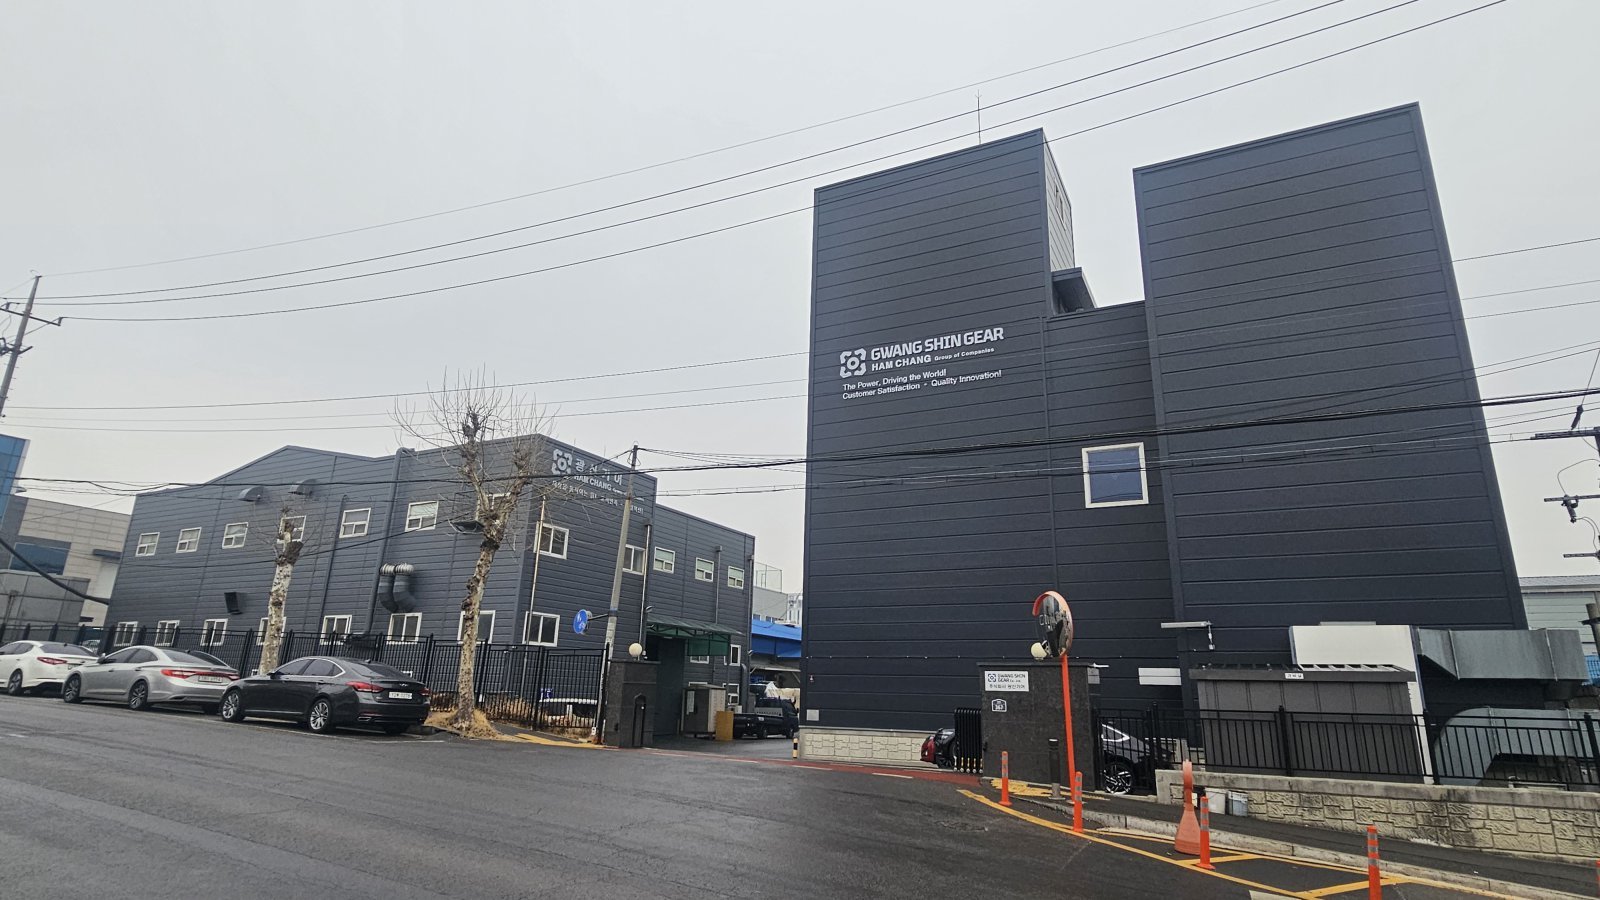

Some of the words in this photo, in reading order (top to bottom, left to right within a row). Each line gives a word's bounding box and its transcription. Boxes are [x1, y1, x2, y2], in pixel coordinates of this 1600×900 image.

[870, 340, 923, 361] GWANG
[924, 334, 962, 353] SHIN
[963, 327, 1004, 345] GEAR
[871, 361, 894, 372] HAM
[895, 354, 932, 369] CHANG
[934, 353, 953, 361] Group
[961, 347, 995, 358] Companies
[842, 383, 856, 391] The
[857, 380, 881, 390] Power,
[883, 374, 908, 386] Driving
[909, 373, 921, 381] the
[922, 369, 947, 379] World!
[842, 389, 876, 400] Customer
[877, 382, 921, 396] Satisfaction
[931, 376, 958, 388] Quality
[958, 370, 1002, 383] Innovation!
[589, 478, 612, 491] CHANG
